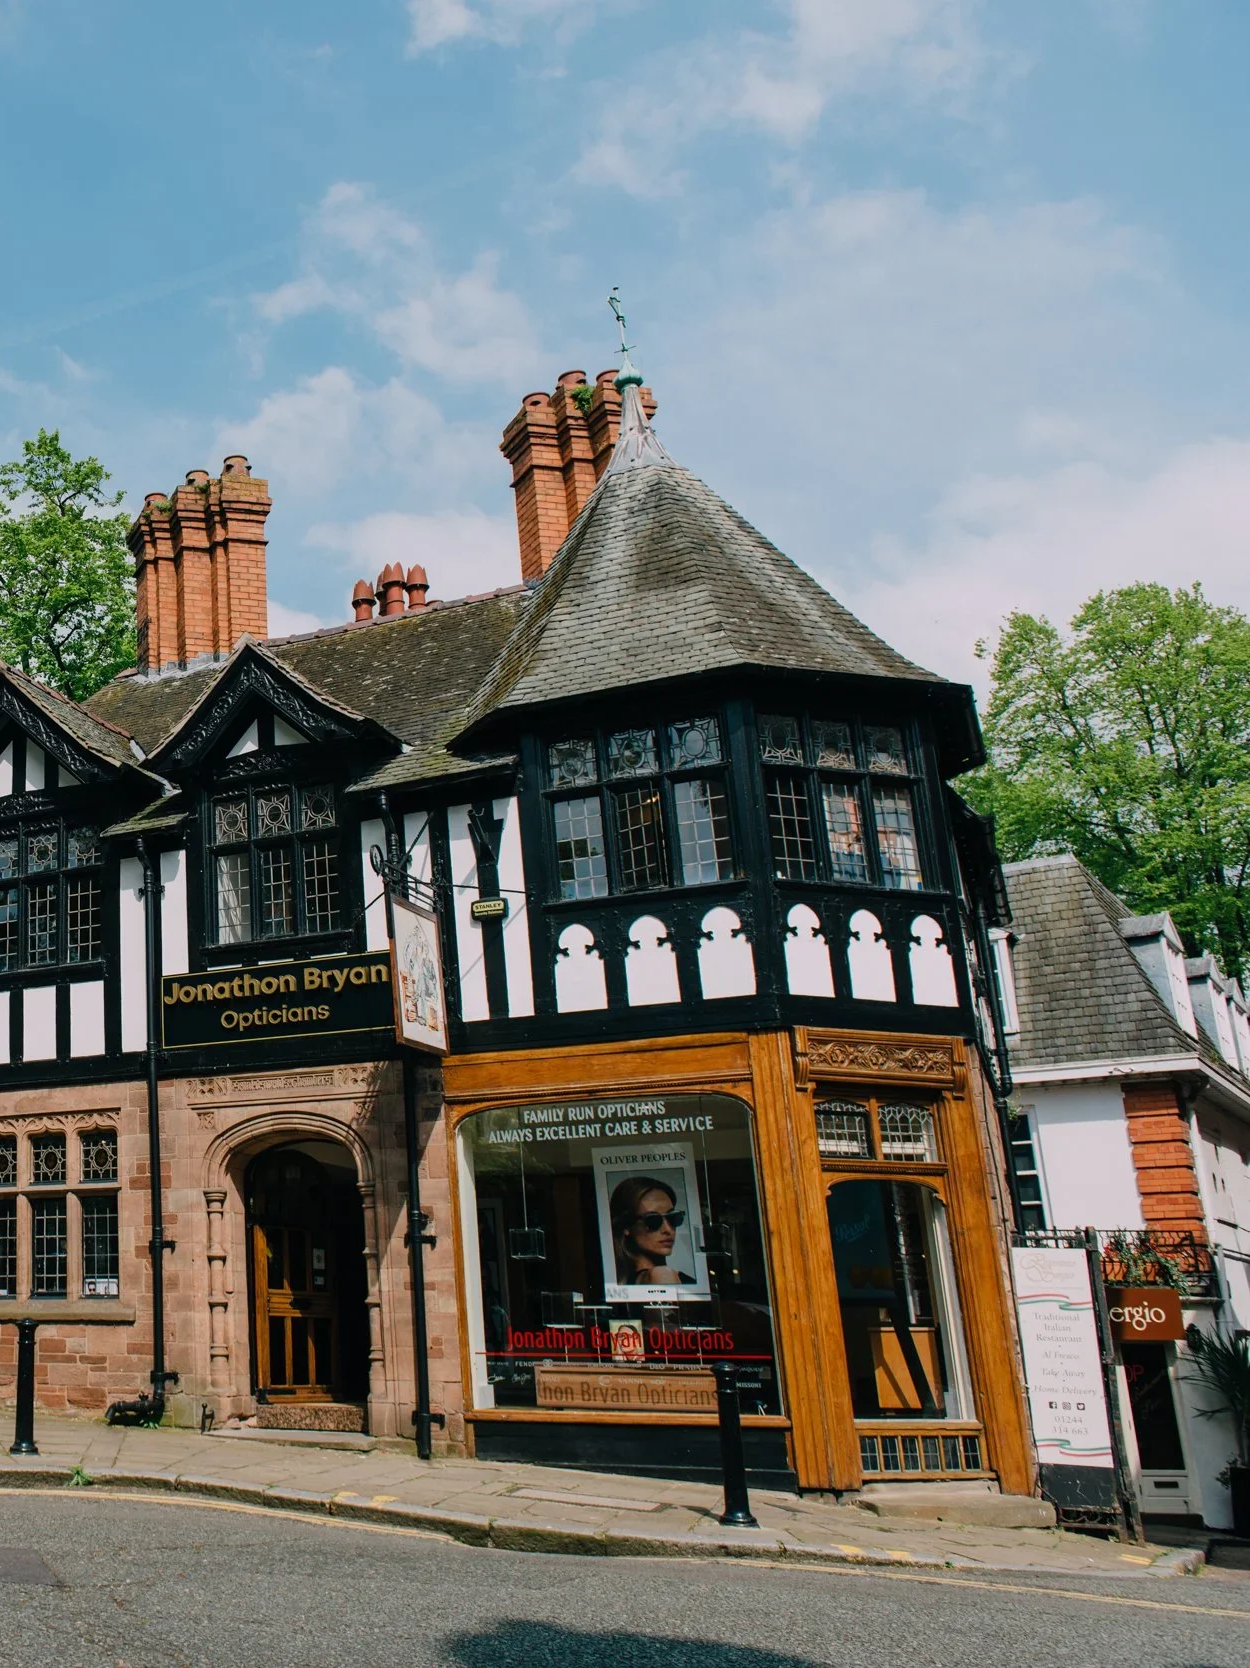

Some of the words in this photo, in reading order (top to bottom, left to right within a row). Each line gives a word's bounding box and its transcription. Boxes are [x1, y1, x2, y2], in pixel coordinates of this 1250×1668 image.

[475, 902, 502, 910] STANLEY
[164, 974, 297, 1005] Jonathon
[304, 963, 389, 992] Bryan
[220, 1004, 330, 1031] Opticians
[524, 1106, 564, 1124] FAMILY
[568, 1105, 595, 1121] RUN
[597, 1100, 665, 1119] OPTICIANS
[488, 1128, 533, 1144] ALWAYS
[536, 1124, 601, 1141] EXCELLENT
[605, 1120, 638, 1137] CARE
[642, 1120, 652, 1134] &
[656, 1116, 714, 1133] SERVICE
[600, 1154, 639, 1165] OLIVER
[641, 1151, 686, 1163] PEOPLES
[1034, 1313, 1080, 1321] Traditional
[1109, 1301, 1166, 1331] ergio
[1044, 1324, 1071, 1332] Italian
[507, 1327, 585, 1351] Jonathon
[591, 1328, 642, 1350] Bryan
[649, 1327, 734, 1350] Opticians
[1036, 1334, 1082, 1342] Restaurant
[1042, 1368, 1060, 1376] Take
[1062, 1369, 1085, 1377] Away
[1032, 1385, 1059, 1393] Home
[1062, 1386, 1098, 1396] Delivery
